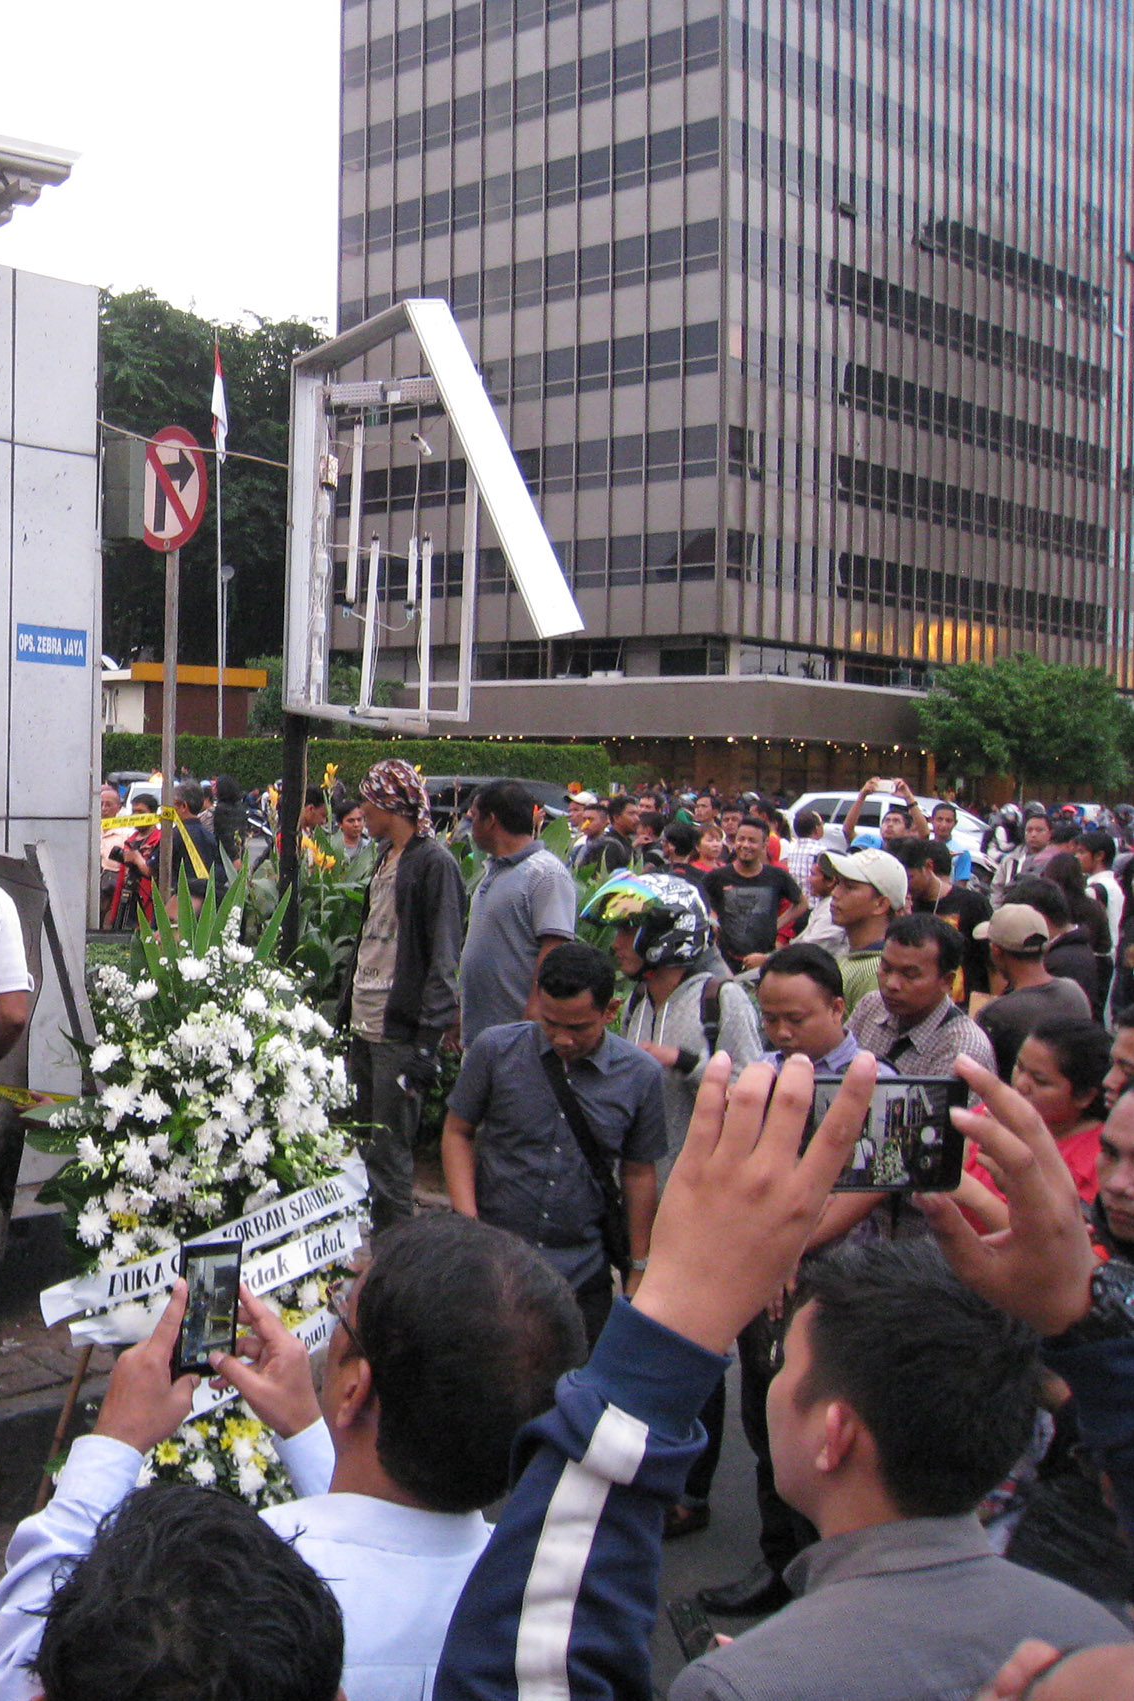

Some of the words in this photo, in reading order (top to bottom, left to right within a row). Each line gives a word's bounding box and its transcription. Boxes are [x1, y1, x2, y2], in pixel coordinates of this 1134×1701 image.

[18, 633, 35, 652] OPS.
[37, 636, 62, 655] ZEBRA
[64, 638, 84, 657] JAYA
[299, 1229, 345, 1265] Takut
[108, 1262, 166, 1297] DUKA
